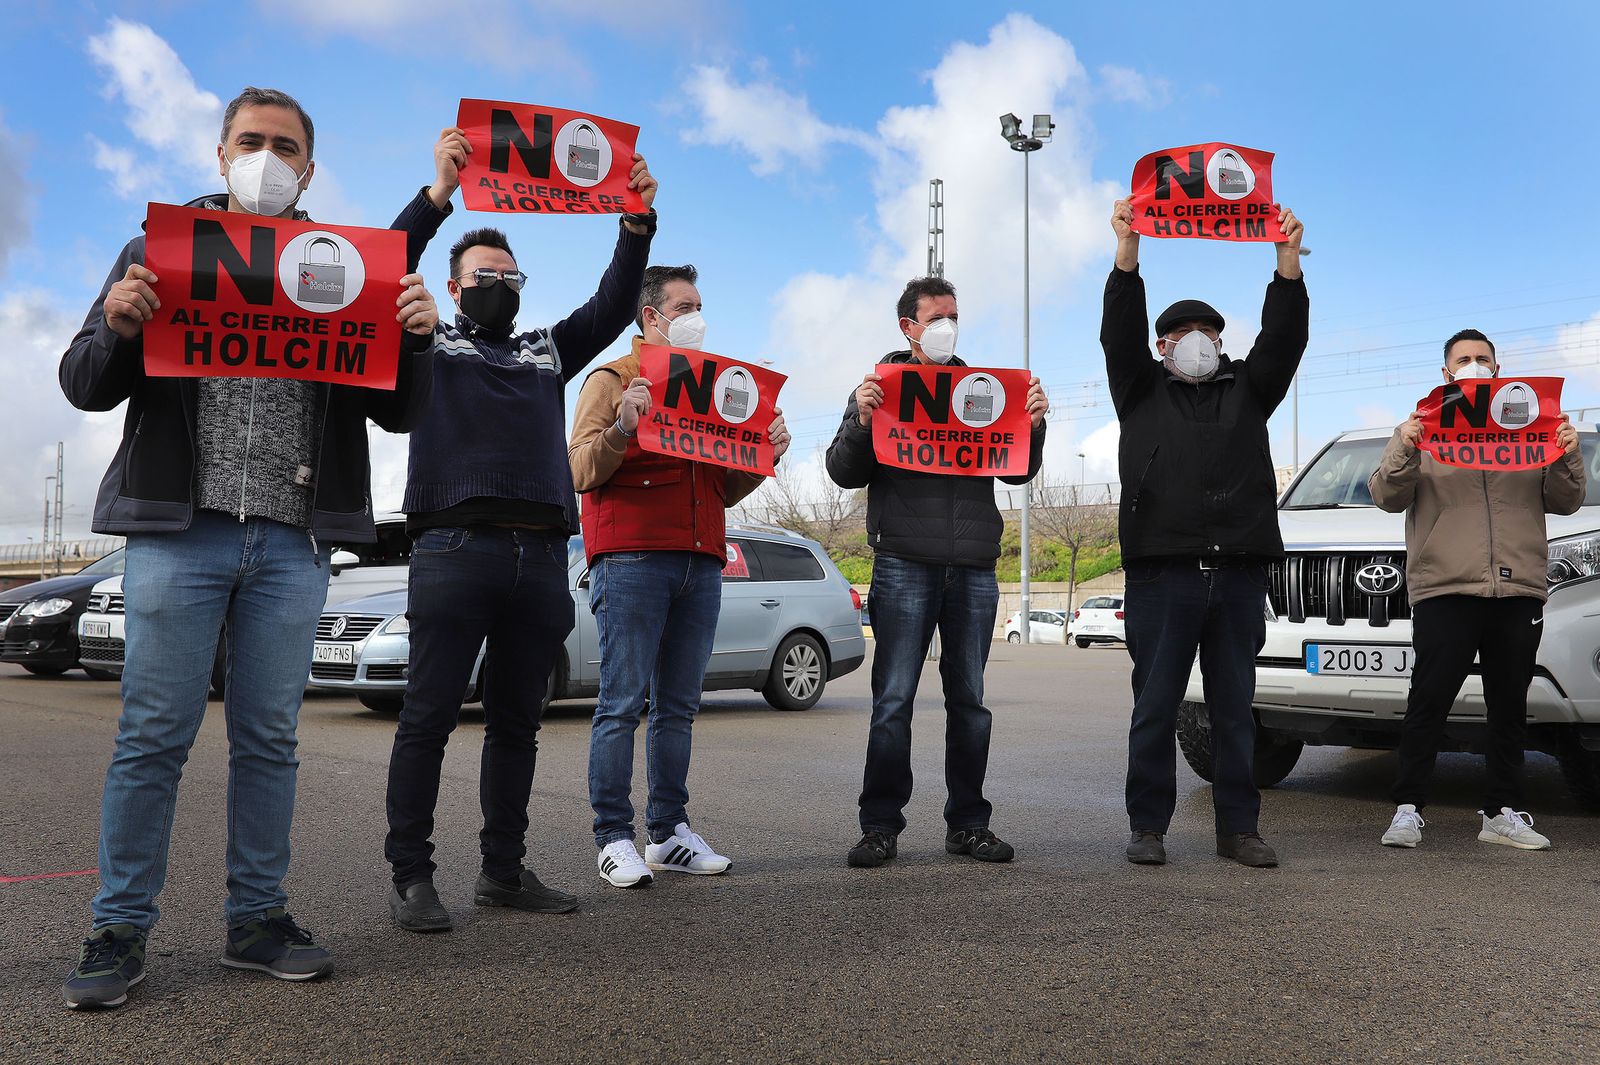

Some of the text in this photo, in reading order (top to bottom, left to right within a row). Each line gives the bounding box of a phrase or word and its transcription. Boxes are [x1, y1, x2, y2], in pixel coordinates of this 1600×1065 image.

[479, 177, 626, 205] AL CIERRE DE
[490, 191, 628, 213] HOLCIM
[1144, 203, 1269, 217] AL CIERRE DE
[1153, 218, 1267, 238] HOLCIM
[309, 279, 343, 293] Holcim
[170, 308, 377, 339] AL CIERRE DE
[184, 331, 367, 375] HOLCIM
[652, 411, 762, 445] AL CIERRE DE
[887, 427, 1014, 445] AL CIERRE DE
[1429, 432, 1549, 443] AL CIERRE DE
[659, 428, 758, 468] HOLCIM
[896, 442, 1009, 470] HOLCIM
[1437, 445, 1546, 465] HOLCIM
[315, 646, 350, 661] 7407 FNS
[1323, 649, 1413, 673] 2003 J
